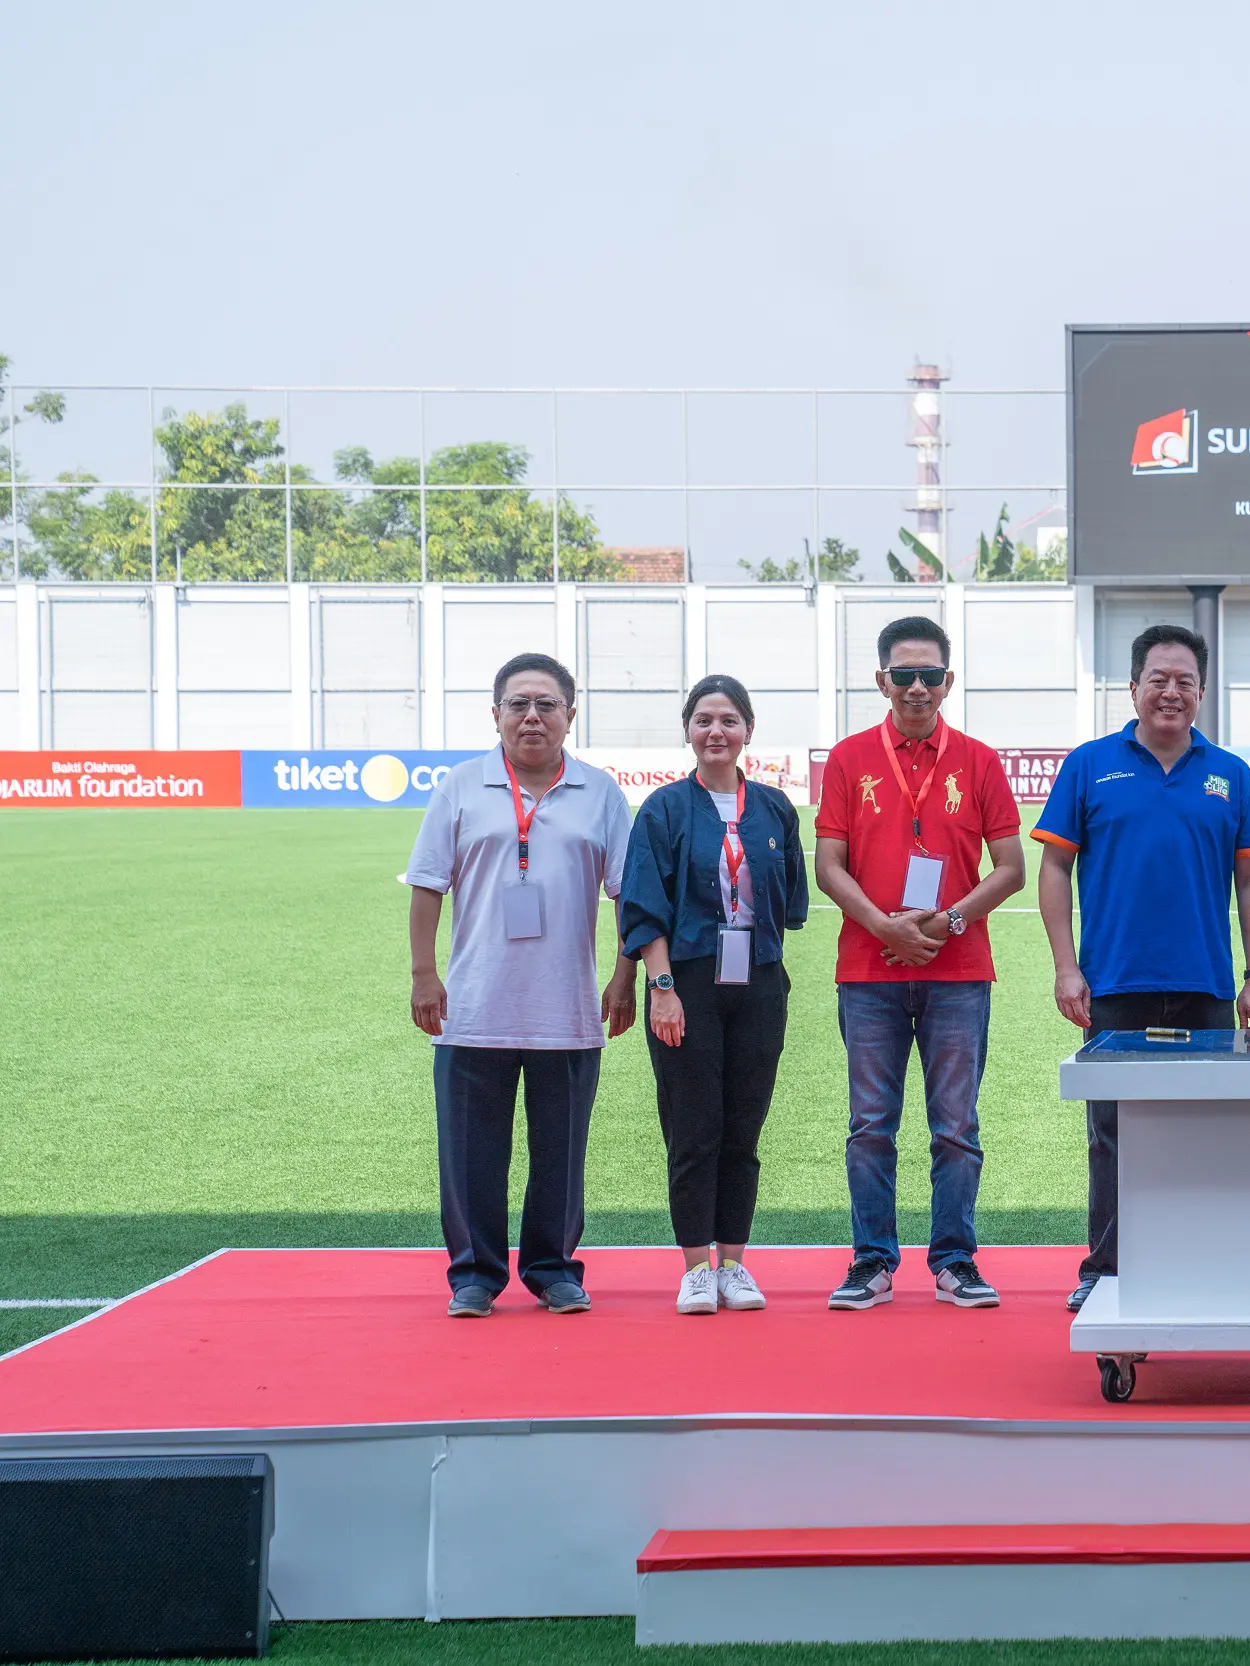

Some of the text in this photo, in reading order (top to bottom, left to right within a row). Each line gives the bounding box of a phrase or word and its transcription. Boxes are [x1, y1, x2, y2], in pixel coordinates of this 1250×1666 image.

[51, 761, 136, 775] Bakti Olahraga
[273, 757, 359, 791] tiket
[77, 774, 204, 798] foundation
[1210, 775, 1228, 788] Milk
[1212, 784, 1228, 796] Life
